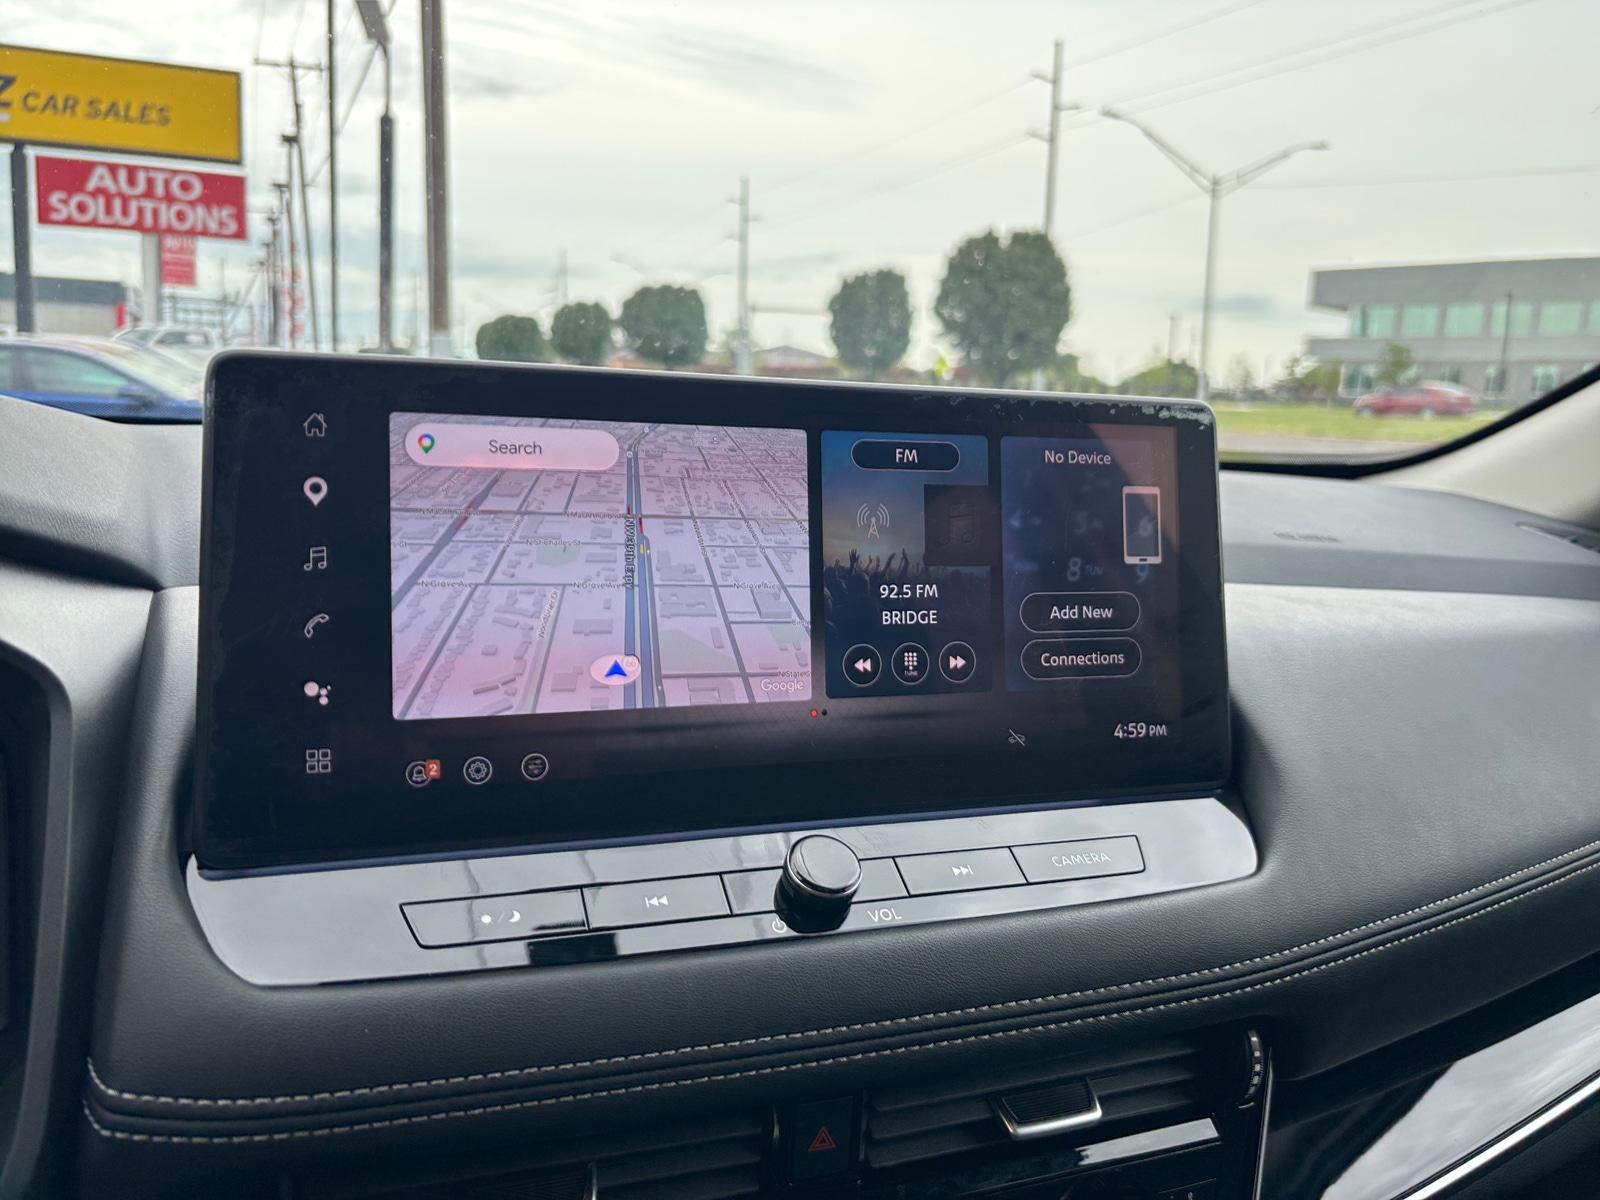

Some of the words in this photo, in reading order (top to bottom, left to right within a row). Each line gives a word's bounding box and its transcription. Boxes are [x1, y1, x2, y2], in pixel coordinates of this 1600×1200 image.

[21, 91, 77, 116] CAR
[86, 98, 172, 127] SALES
[84, 165, 203, 201] AUTO
[48, 190, 238, 235] SOLUTIONS
[488, 439, 543, 455] Search
[895, 448, 918, 463] FM
[1044, 450, 1064, 463] No
[1068, 450, 1111, 464] Device
[625, 517, 635, 537] NW
[625, 538, 635, 561] 39th
[431, 580, 455, 588] Grove
[458, 580, 474, 588] Ave
[623, 564, 635, 589] Expy
[582, 581, 605, 589] Grove
[879, 585, 912, 598] 92.5
[916, 584, 938, 598] FM
[882, 610, 938, 625] BRIDGE
[1050, 605, 1078, 619] Add
[1082, 605, 1113, 618] New
[1040, 652, 1125, 666] Connections
[761, 678, 804, 693] Google
[1113, 722, 1146, 738] 4:59
[1149, 724, 1167, 737] PM
[428, 763, 437, 776] 2
[1051, 851, 1111, 868] CAMERA
[867, 906, 902, 923] VOL
